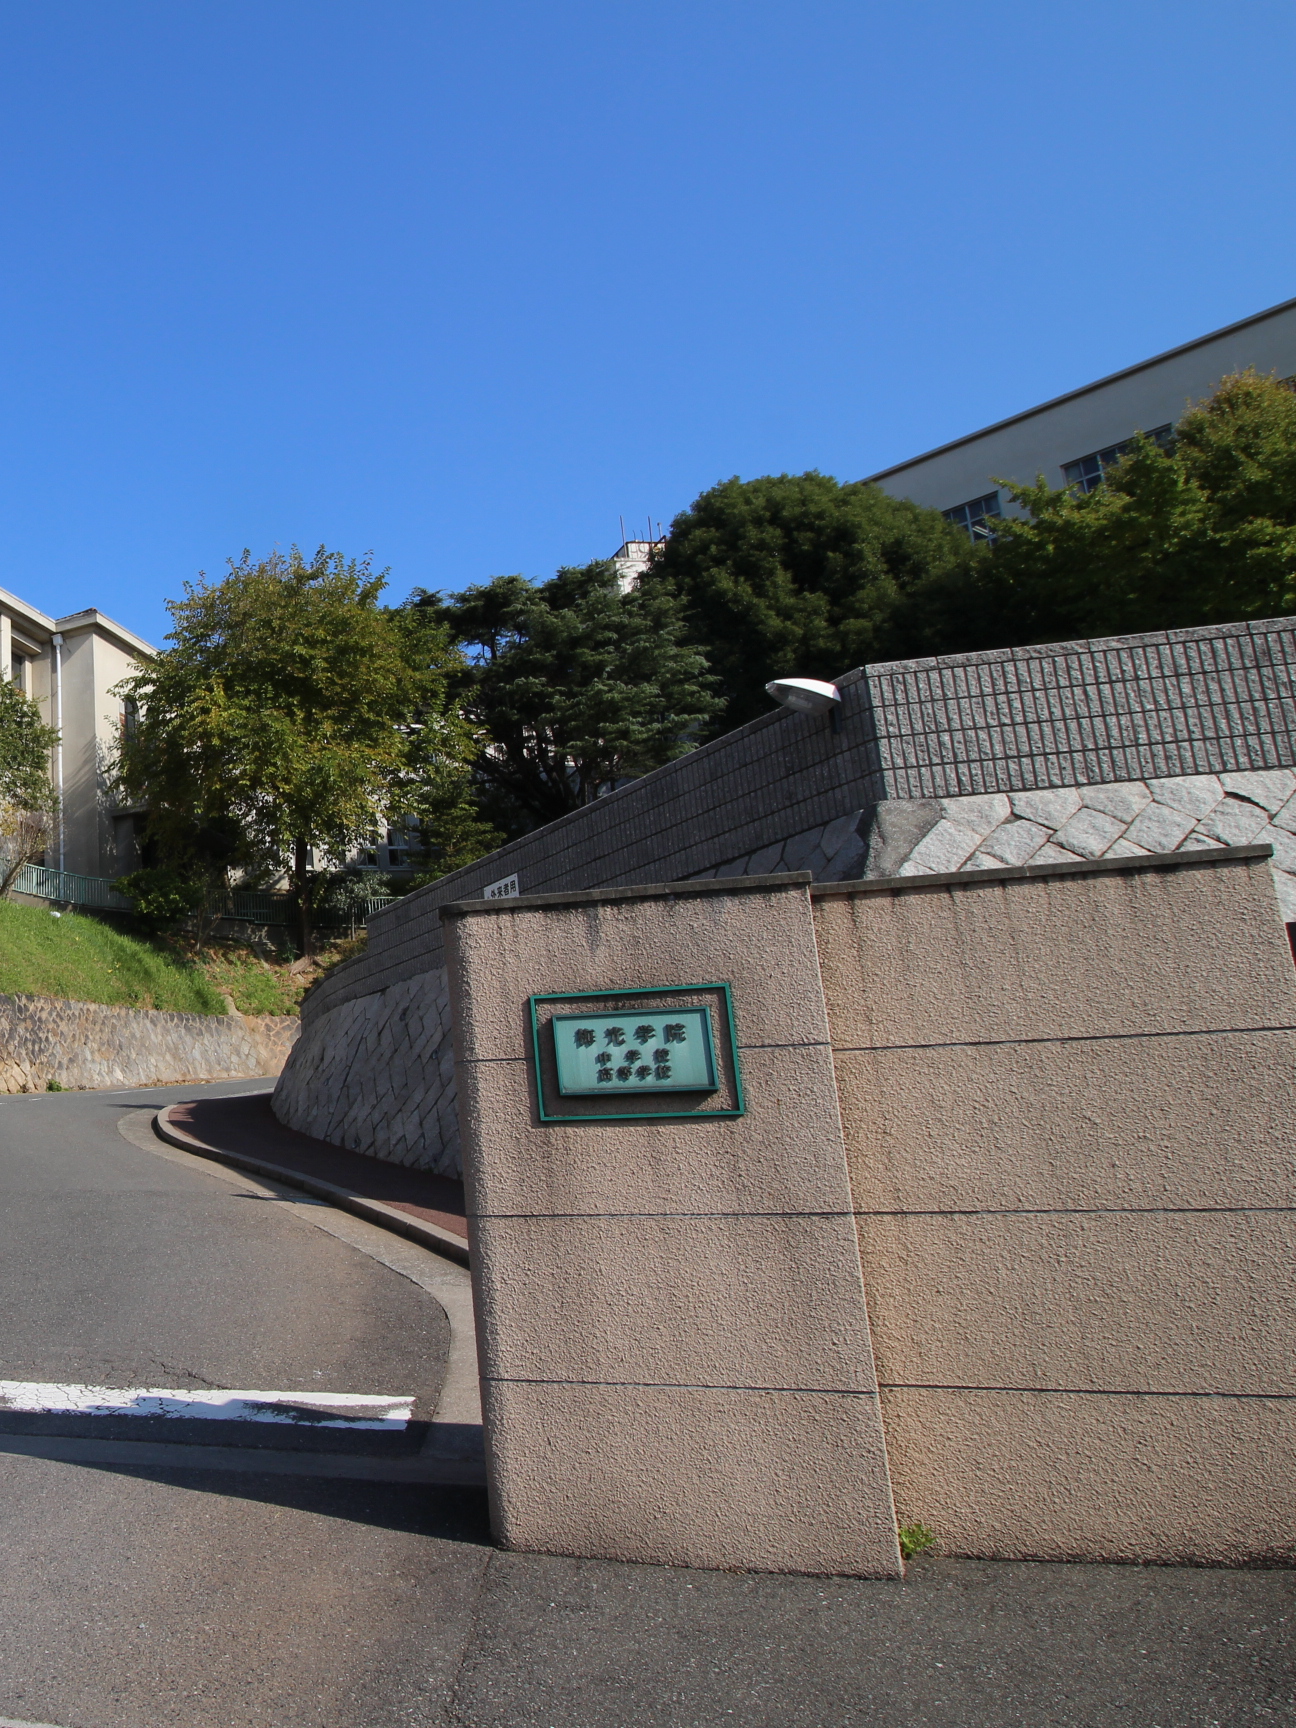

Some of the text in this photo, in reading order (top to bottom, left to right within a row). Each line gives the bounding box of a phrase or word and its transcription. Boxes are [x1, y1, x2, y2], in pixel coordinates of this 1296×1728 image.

[576, 1023, 686, 1047] 梅光学院
[597, 1048, 670, 1066] 中学校
[597, 1065, 672, 1083] 高等学校
